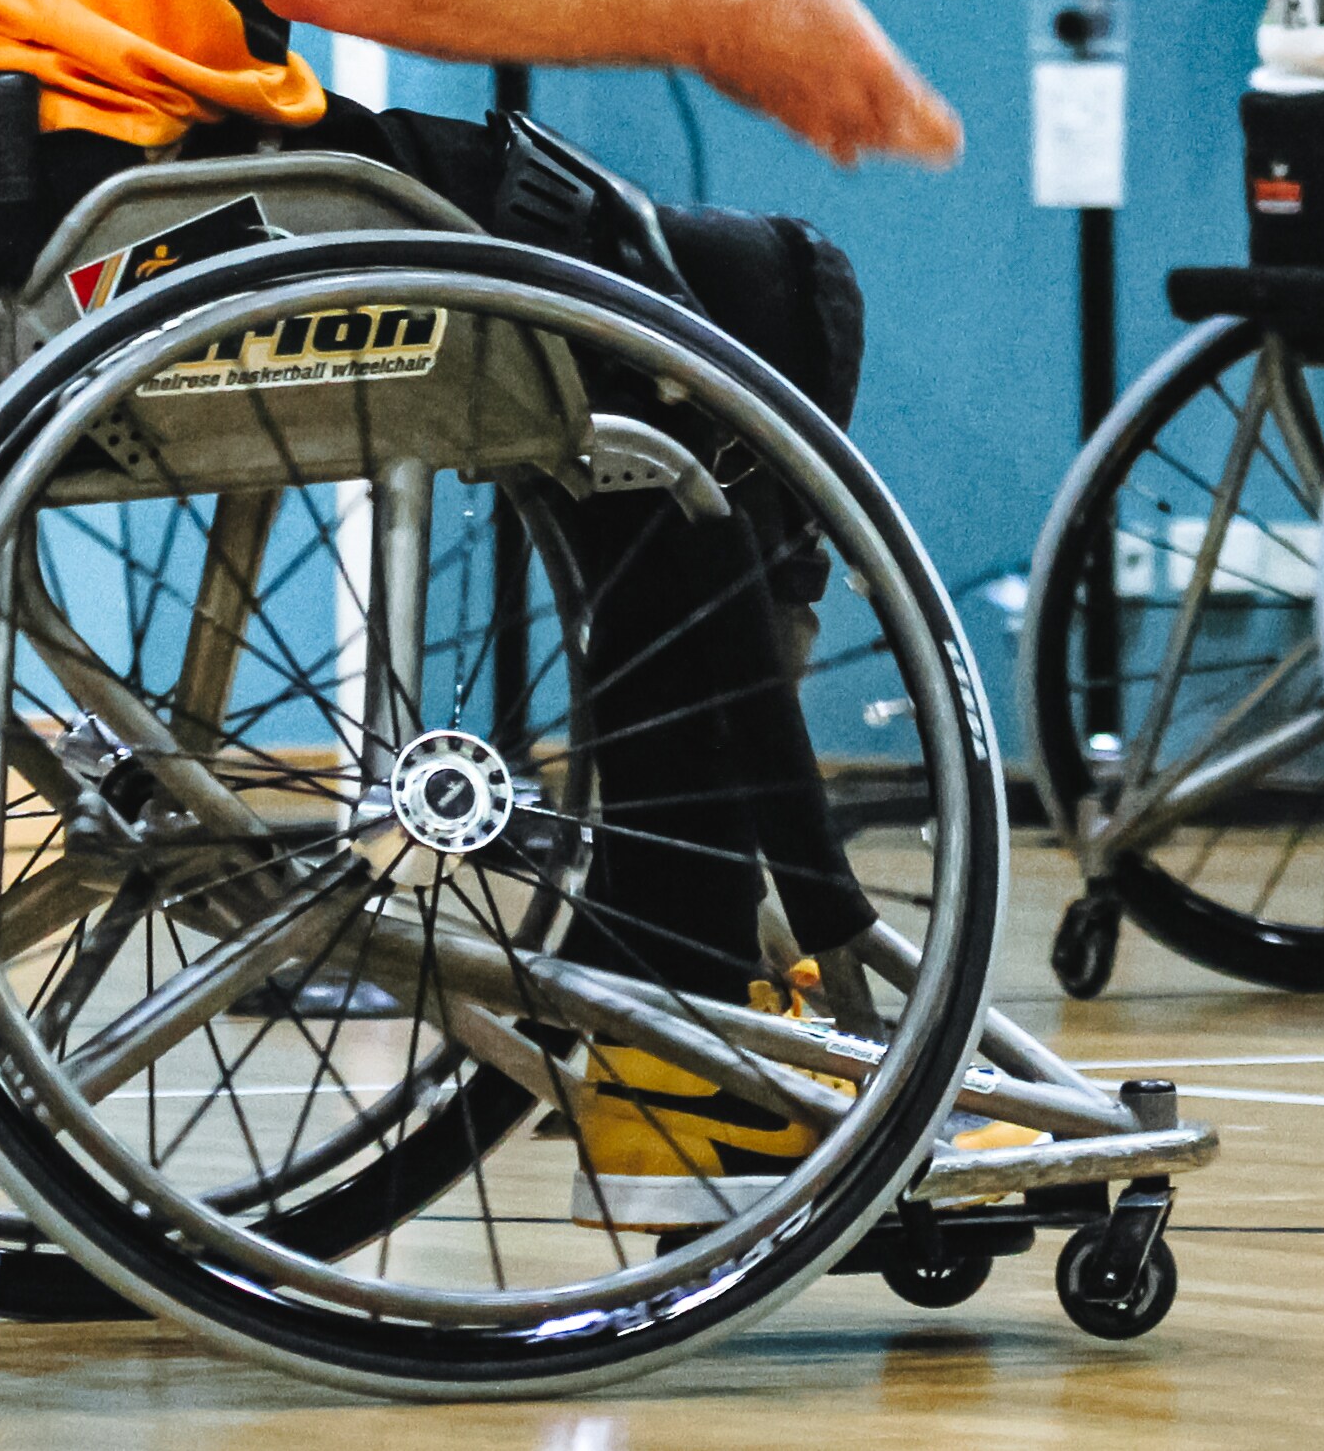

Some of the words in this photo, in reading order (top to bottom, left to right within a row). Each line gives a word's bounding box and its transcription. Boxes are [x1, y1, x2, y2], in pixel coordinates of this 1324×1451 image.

[144, 373, 221, 392] melrose
[226, 362, 327, 386] basketball
[332, 354, 432, 377] wheelchair
